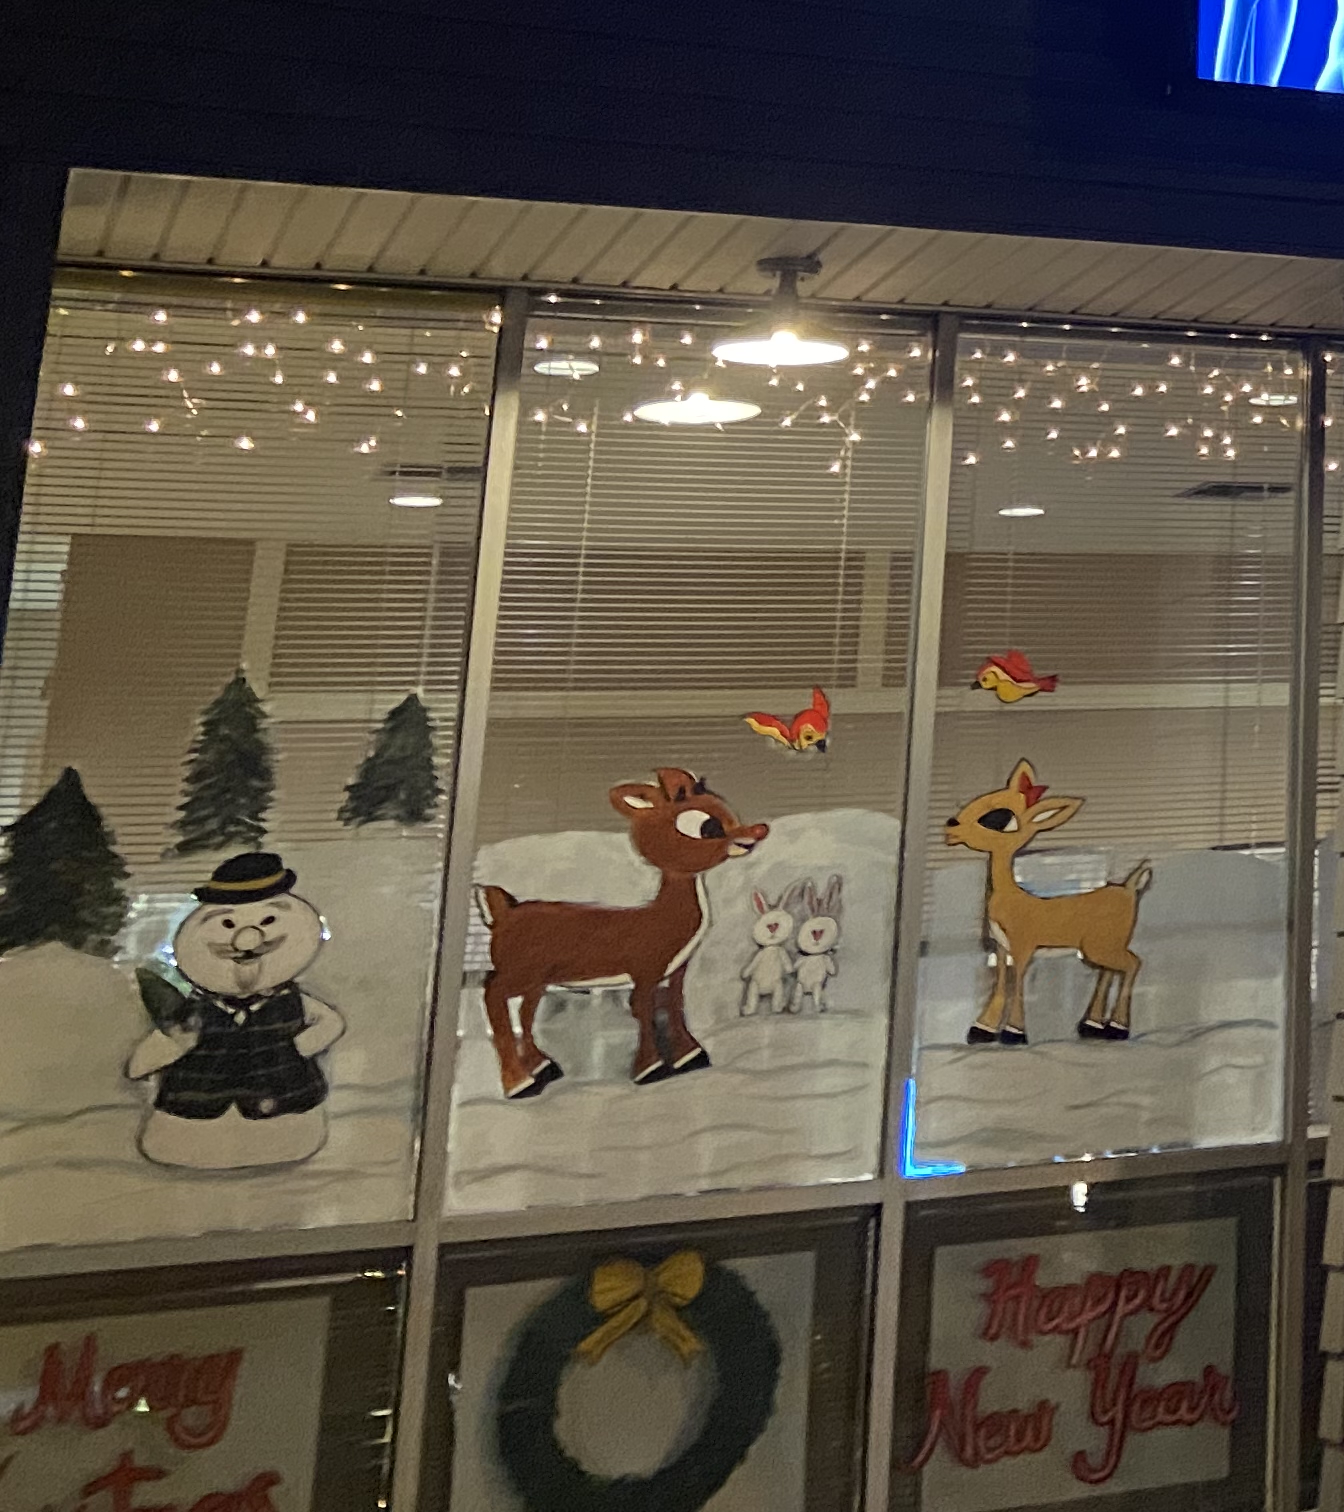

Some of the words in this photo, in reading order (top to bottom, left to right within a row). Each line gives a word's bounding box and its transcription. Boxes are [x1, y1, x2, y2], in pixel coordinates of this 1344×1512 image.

[979, 1254, 1217, 1369] Happy
[903, 1366, 1059, 1469] New
[1071, 1353, 1240, 1484] Year
